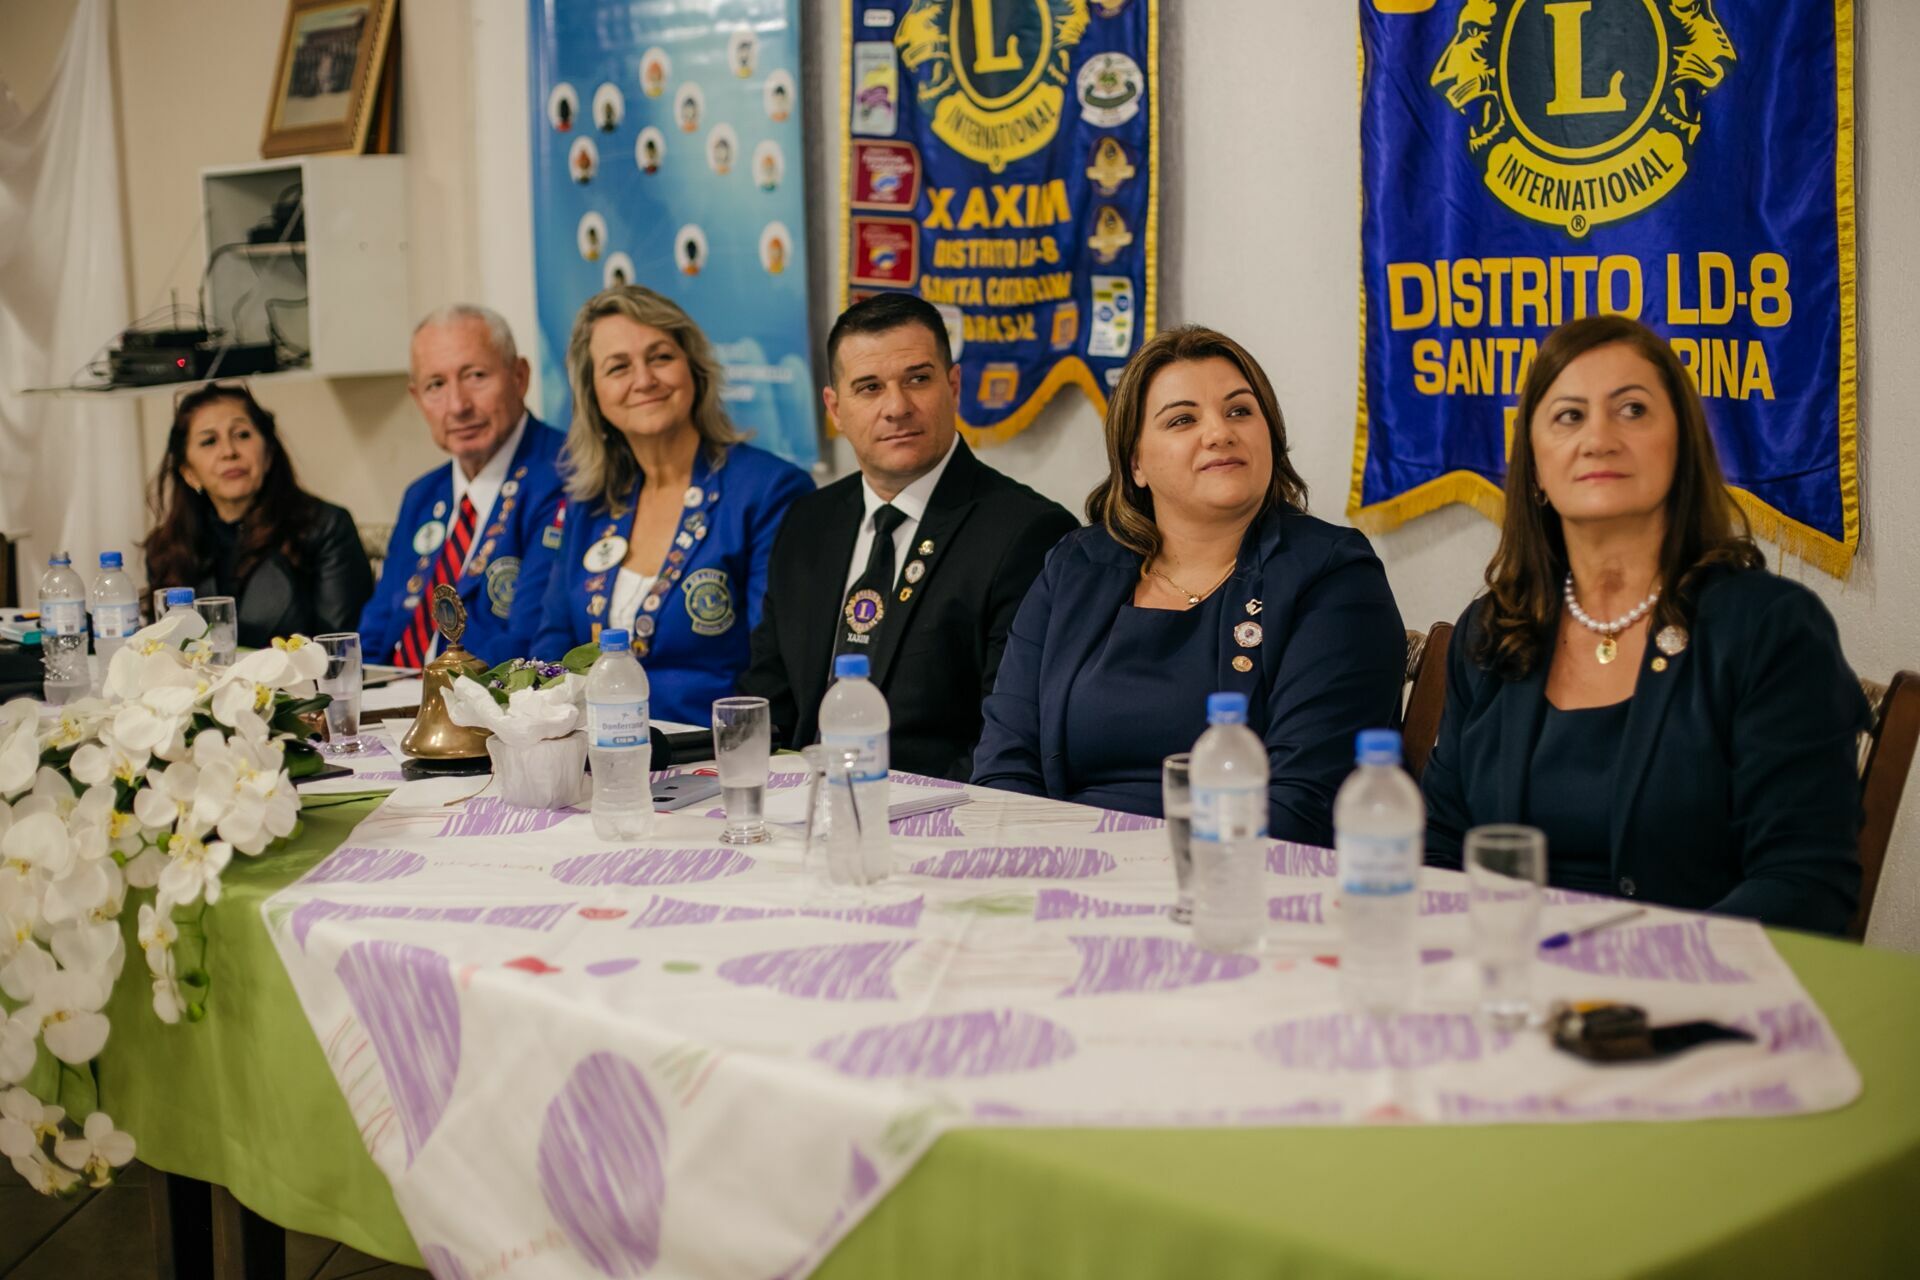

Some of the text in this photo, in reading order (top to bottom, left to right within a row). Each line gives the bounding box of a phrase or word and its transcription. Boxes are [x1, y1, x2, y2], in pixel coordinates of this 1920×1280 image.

[972, 0, 1024, 74] L
[1544, 0, 1627, 116] L
[945, 100, 1056, 150] INTERNATIONAL
[922, 179, 1072, 231] XAXIM
[1496, 148, 1674, 211] INTERNATIONAL
[920, 273, 984, 306] SANTA
[1386, 251, 1793, 331] DISTRITO LD-8
[1669, 337, 1776, 401] RINA
